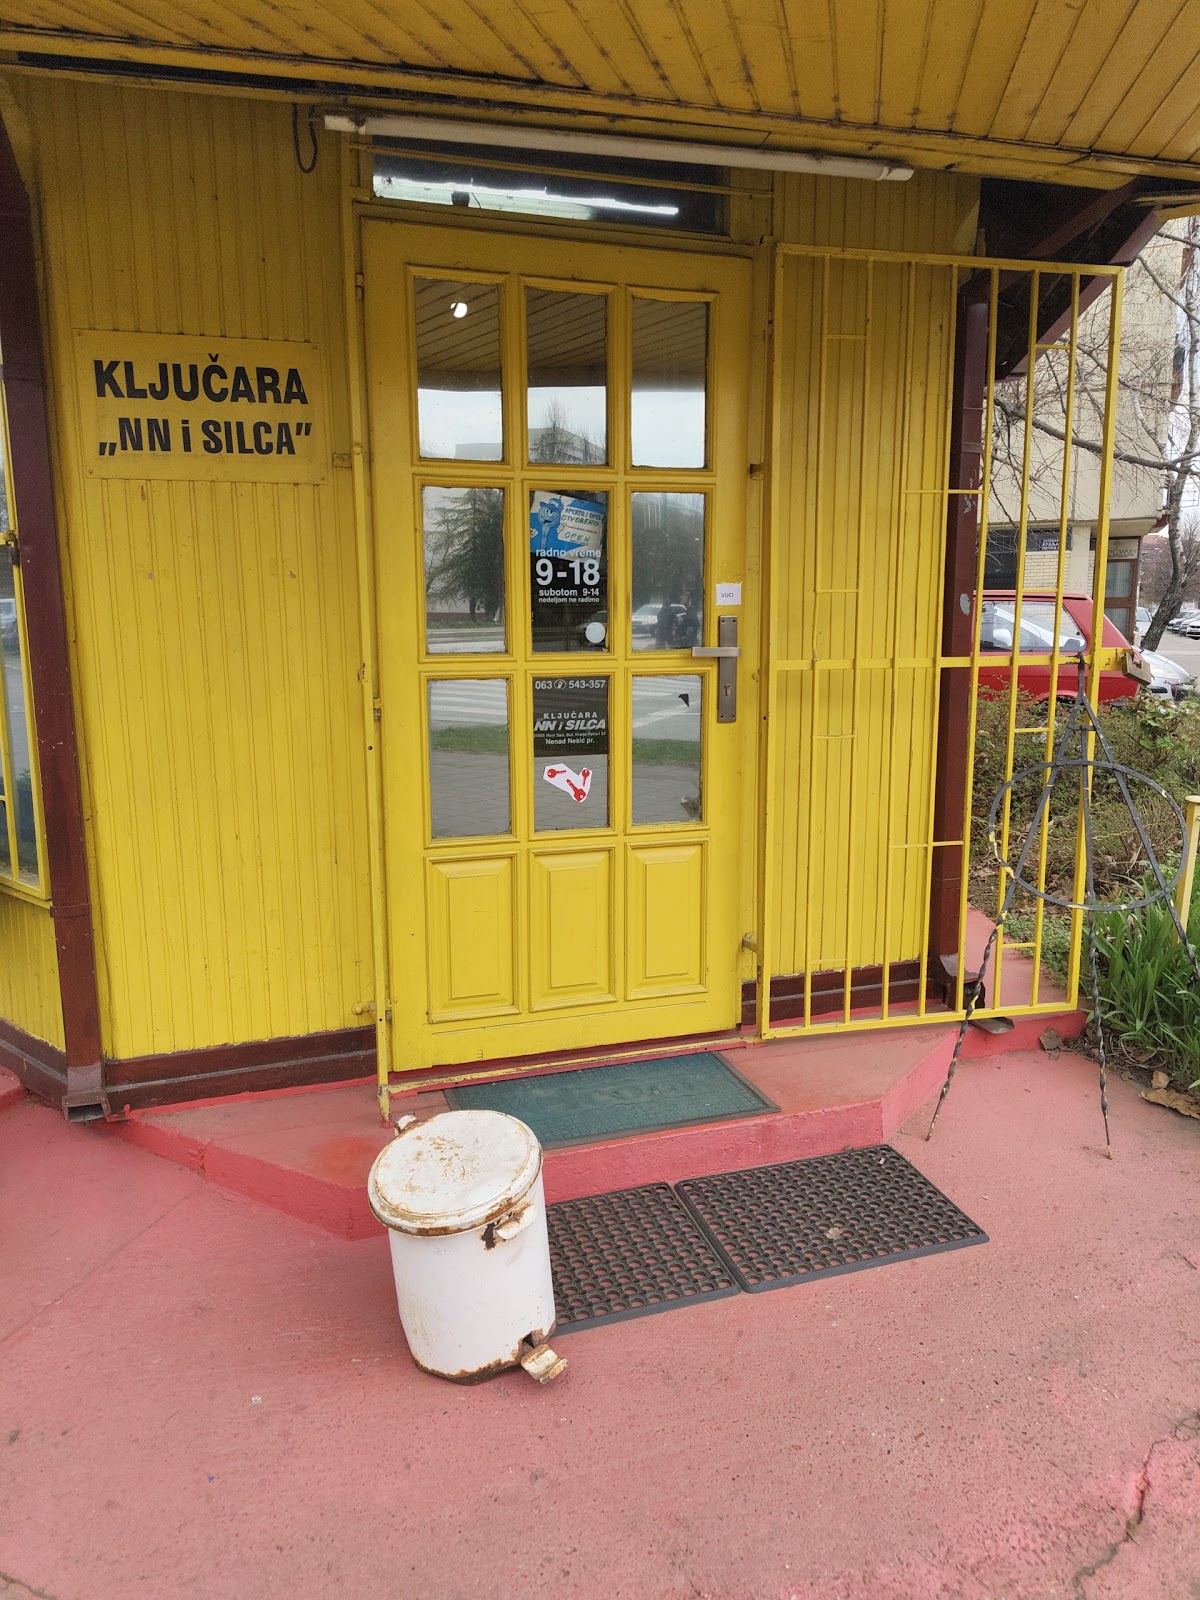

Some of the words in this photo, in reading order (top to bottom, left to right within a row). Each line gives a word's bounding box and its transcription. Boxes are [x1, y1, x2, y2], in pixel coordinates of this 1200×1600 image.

[94, 353, 309, 405] KLJUČARA
[181, 420, 192, 453] i
[561, 515, 599, 526] OTVORENO
[564, 531, 591, 543] OPEN
[535, 547, 567, 558] radno
[569, 549, 602, 558] vreme
[538, 588, 578, 597] subotom
[582, 587, 600, 597] 9-14
[538, 596, 568, 605] nedeljom
[535, 681, 553, 689] 063
[568, 679, 606, 689] 543-357
[543, 711, 598, 719] KLJUČARA
[534, 720, 557, 732] NN
[557, 722, 564, 731] i
[564, 719, 606, 731] SILCA
[567, 736, 586, 744] Nešić
[586, 737, 595, 745] pr.
